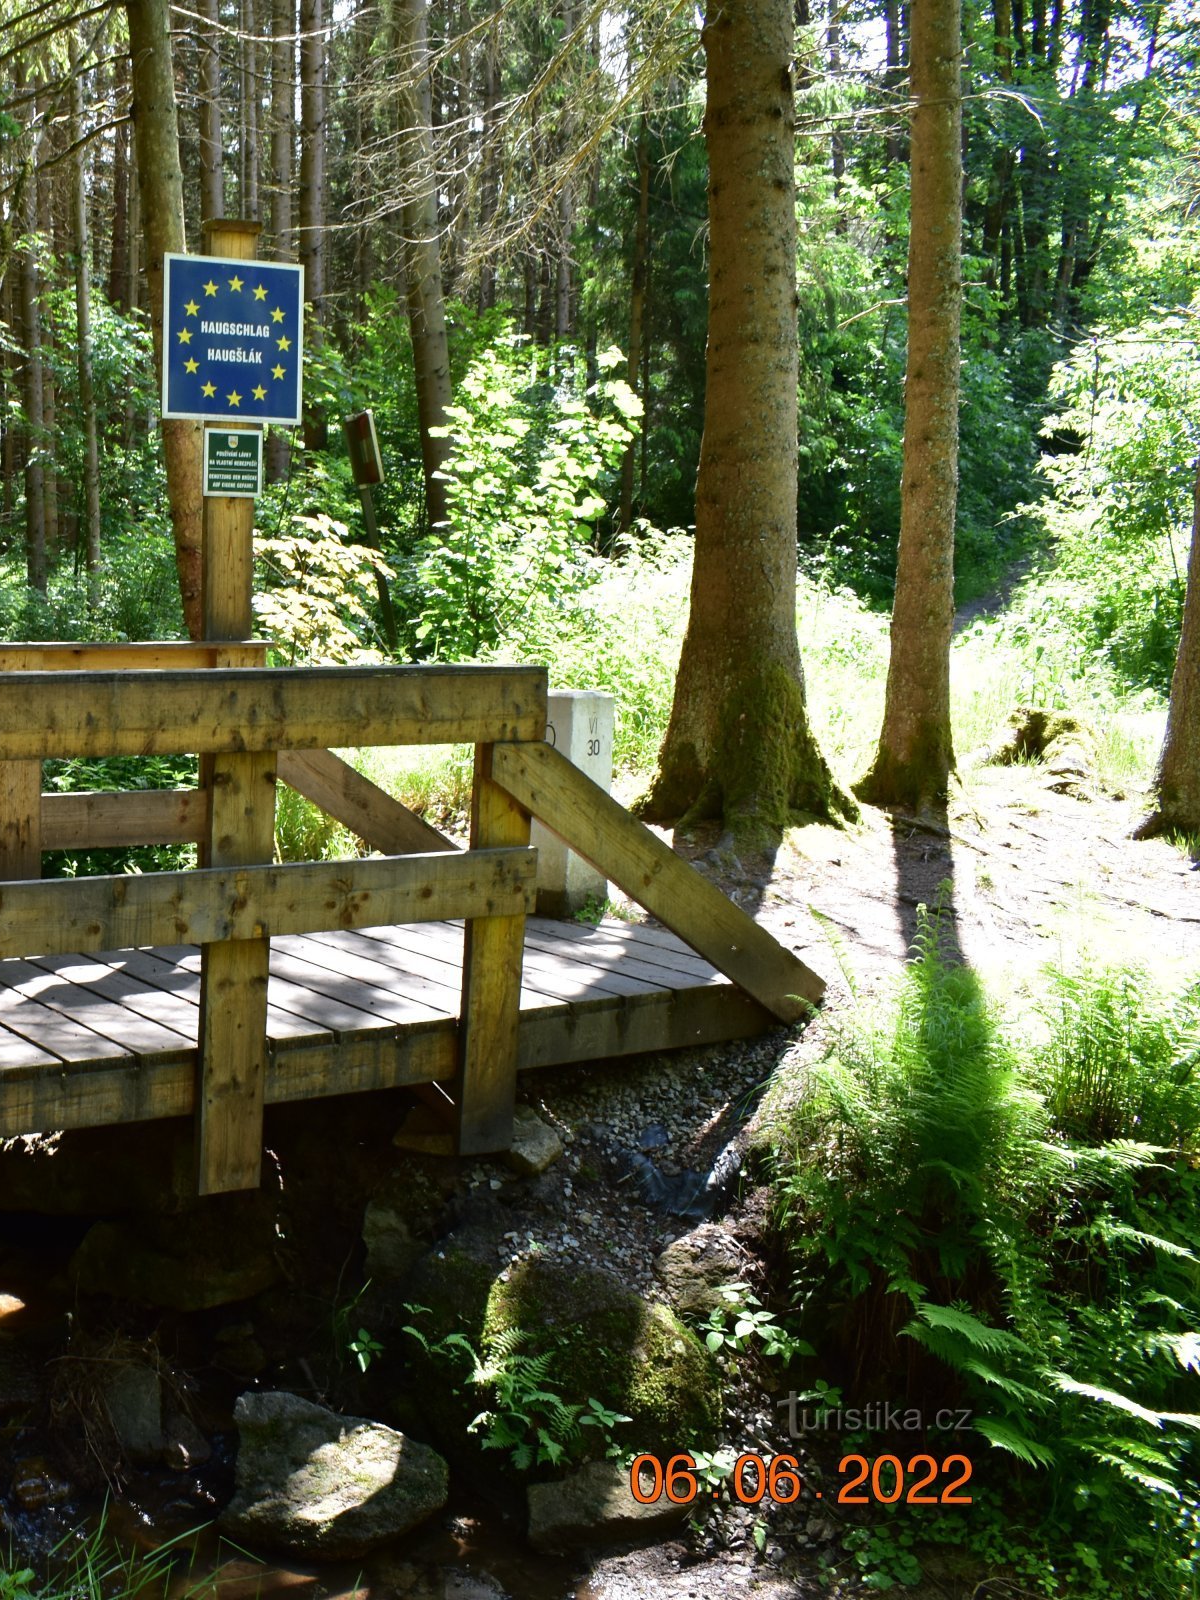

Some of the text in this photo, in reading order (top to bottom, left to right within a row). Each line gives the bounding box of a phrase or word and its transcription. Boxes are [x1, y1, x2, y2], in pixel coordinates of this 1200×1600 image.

[201, 320, 270, 338] HAUGSCHLAG
[207, 347, 262, 364] HAUGŠLÁK
[587, 739, 600, 756] 30
